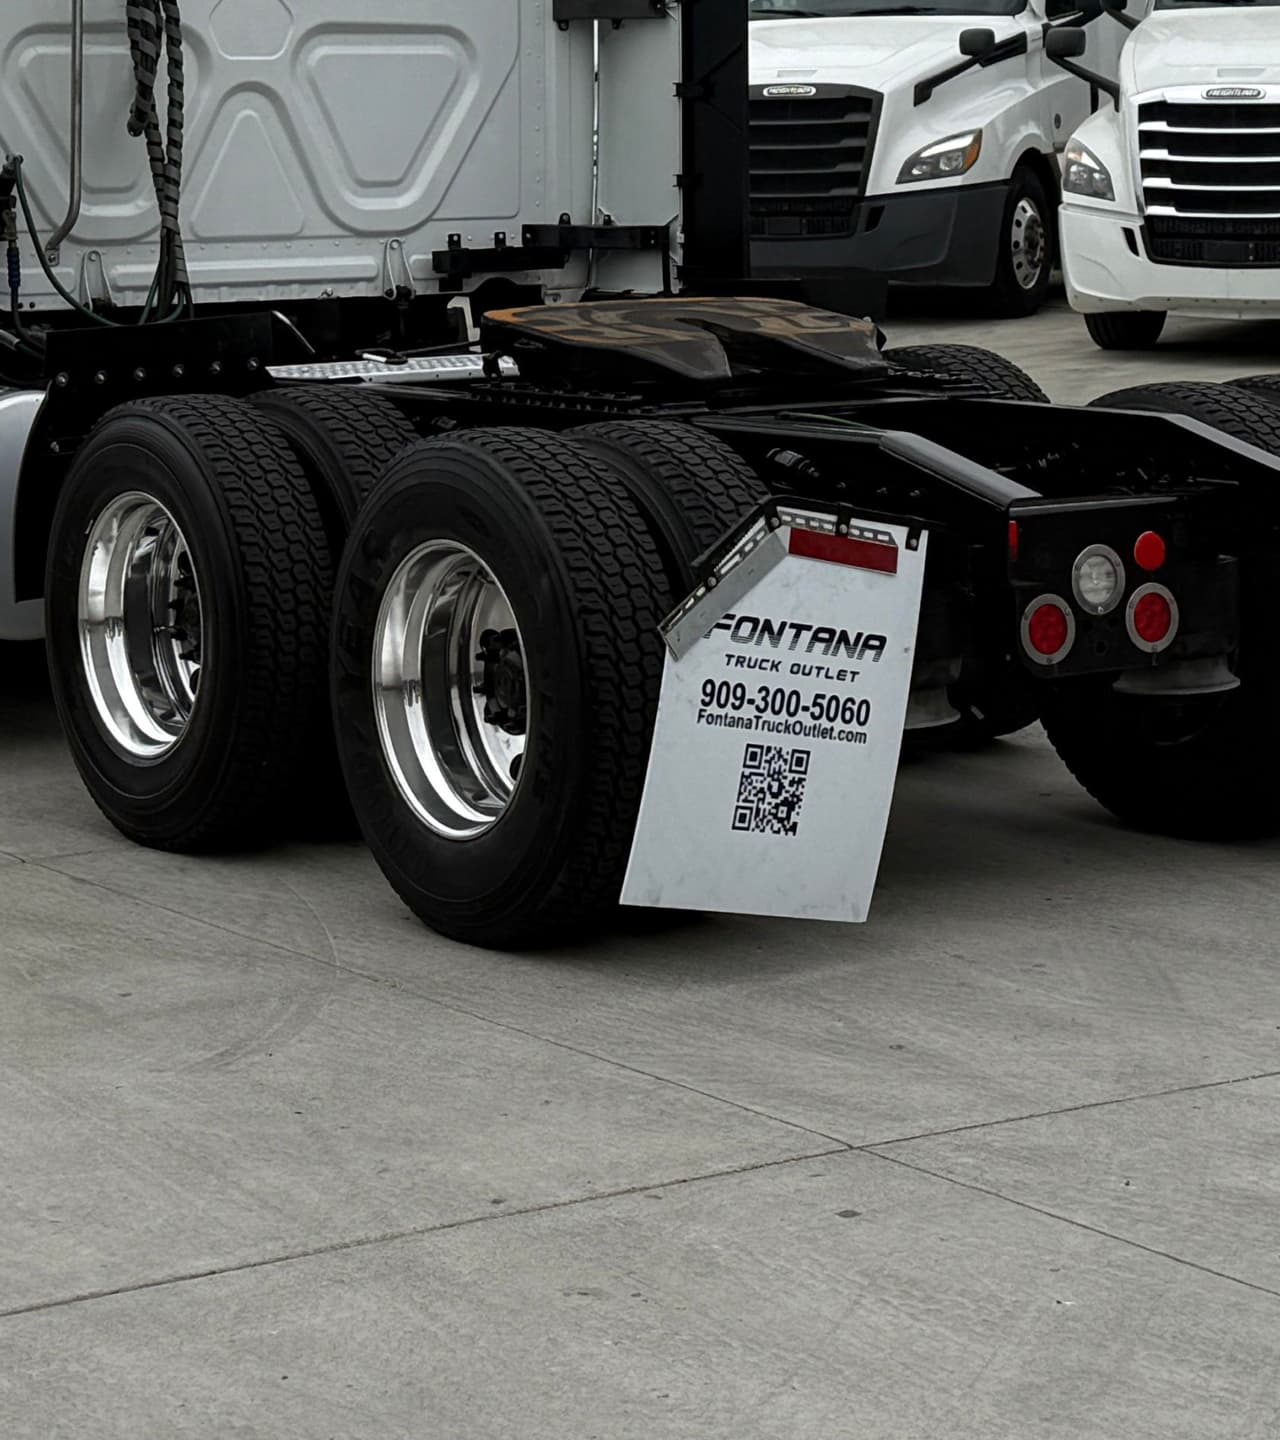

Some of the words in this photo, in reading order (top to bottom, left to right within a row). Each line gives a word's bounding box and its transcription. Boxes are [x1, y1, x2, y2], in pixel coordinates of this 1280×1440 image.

[703, 613, 887, 662] FONTANA
[724, 653, 782, 673] TRUCK
[789, 662, 861, 683] OUTLET
[700, 679, 871, 727] 909-300-5060
[696, 708, 867, 745] FontanaTruckOutlet.com
